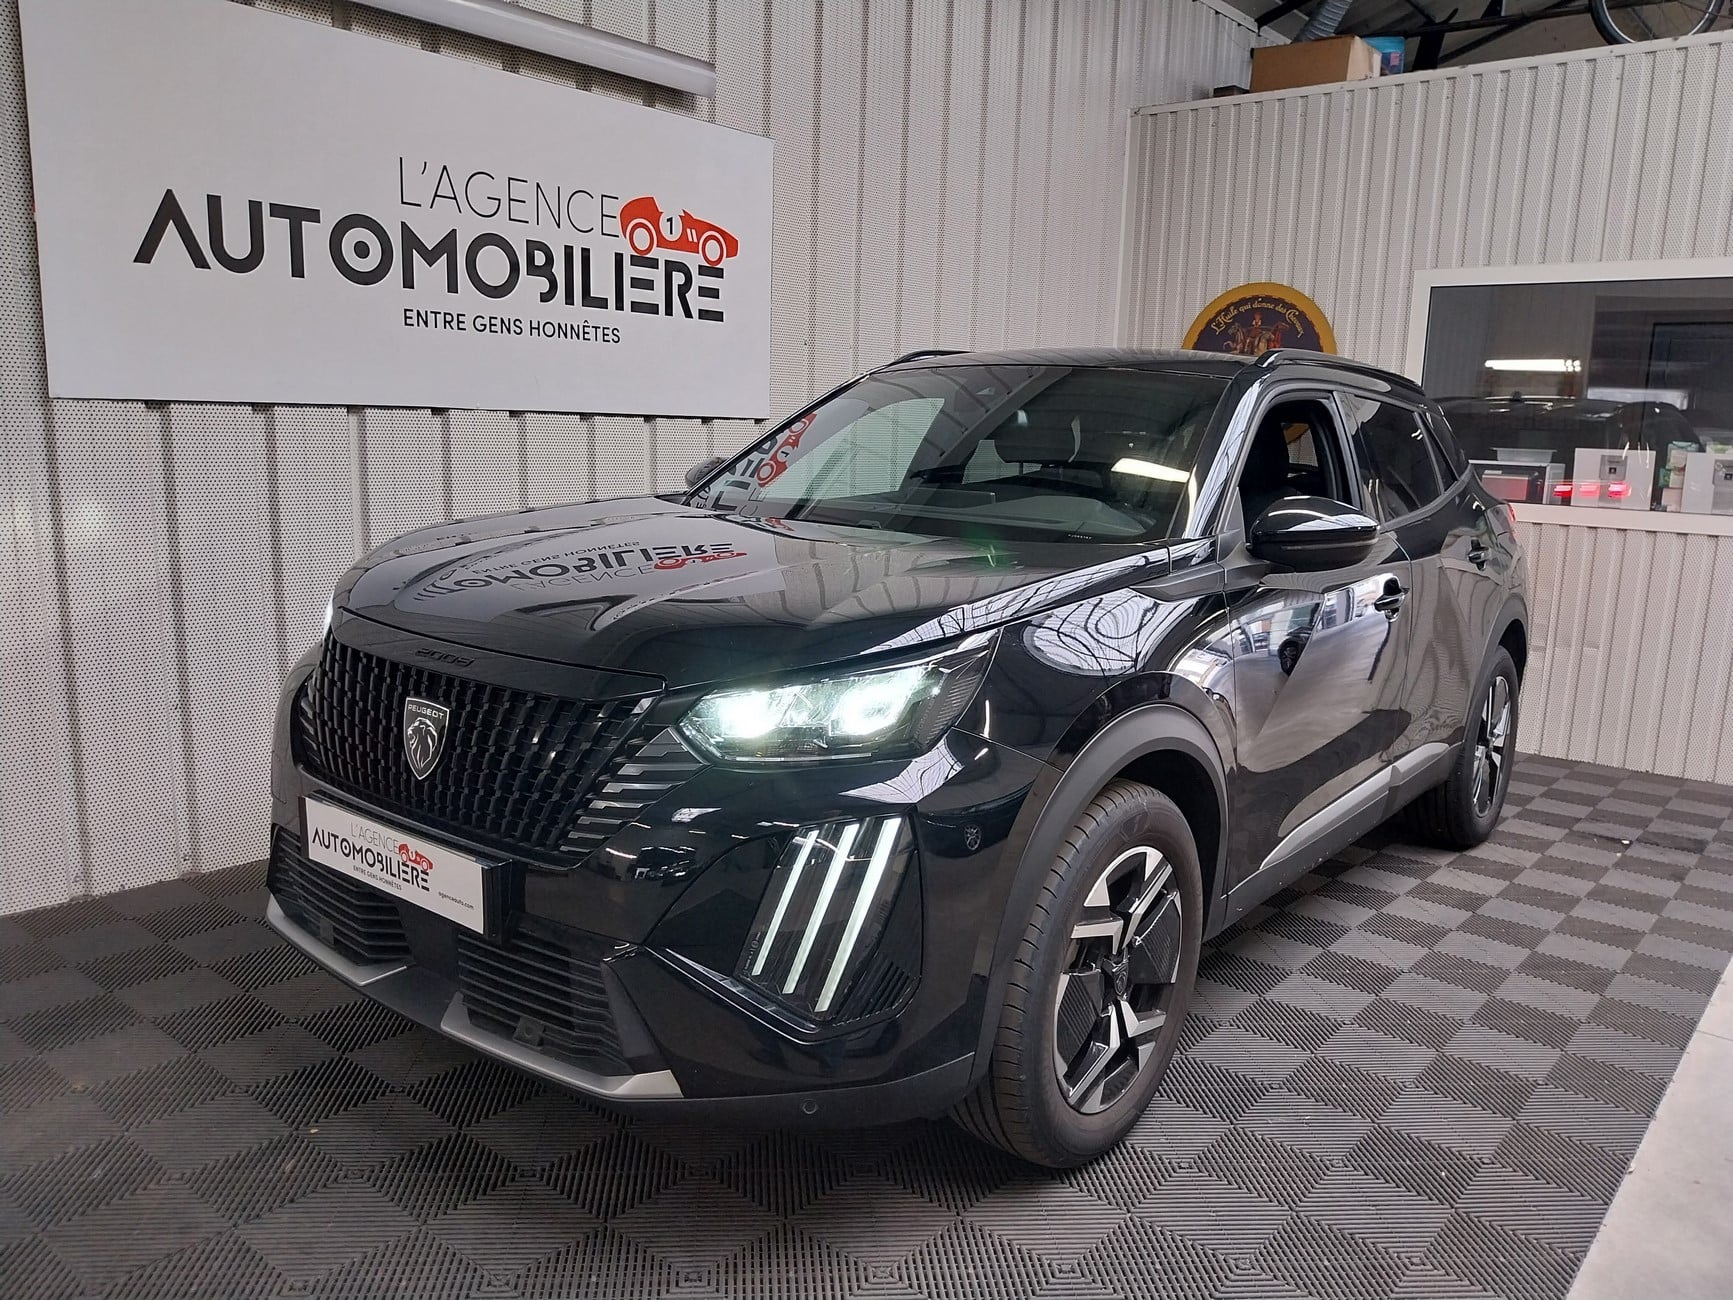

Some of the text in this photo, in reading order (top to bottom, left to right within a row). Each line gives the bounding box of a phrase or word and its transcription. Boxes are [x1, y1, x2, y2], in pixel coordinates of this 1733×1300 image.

[399, 156, 620, 239] L'AGENCE
[666, 216, 674, 236] 1
[132, 187, 725, 323] AUTOMOBILIERE
[1239, 302, 1251, 313] qui
[1275, 303, 1287, 314] des
[403, 308, 621, 344] ENTRE GENS HONNÊTES
[407, 704, 445, 720] PEUGEOT
[350, 821, 400, 855] L'AGENCE
[312, 826, 430, 892] AUTOMOBILIERE
[353, 865, 366, 876] ENTRE
[366, 870, 379, 881] GENS
